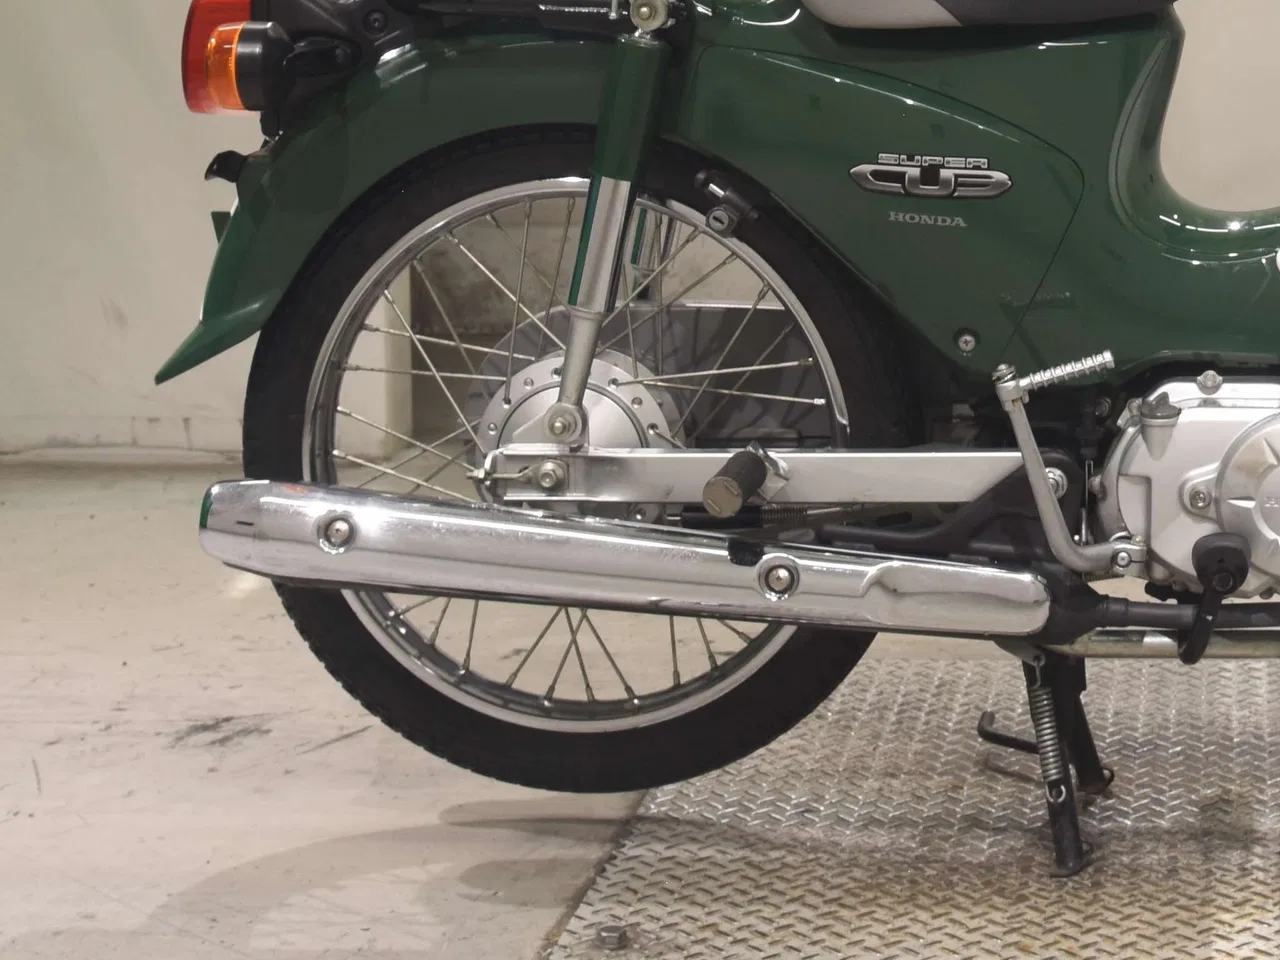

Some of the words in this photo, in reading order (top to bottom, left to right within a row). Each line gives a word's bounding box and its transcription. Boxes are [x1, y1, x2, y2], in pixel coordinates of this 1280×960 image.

[878, 153, 988, 168] SUPER
[850, 164, 1012, 198] CUP
[888, 211, 967, 227] HONDA
